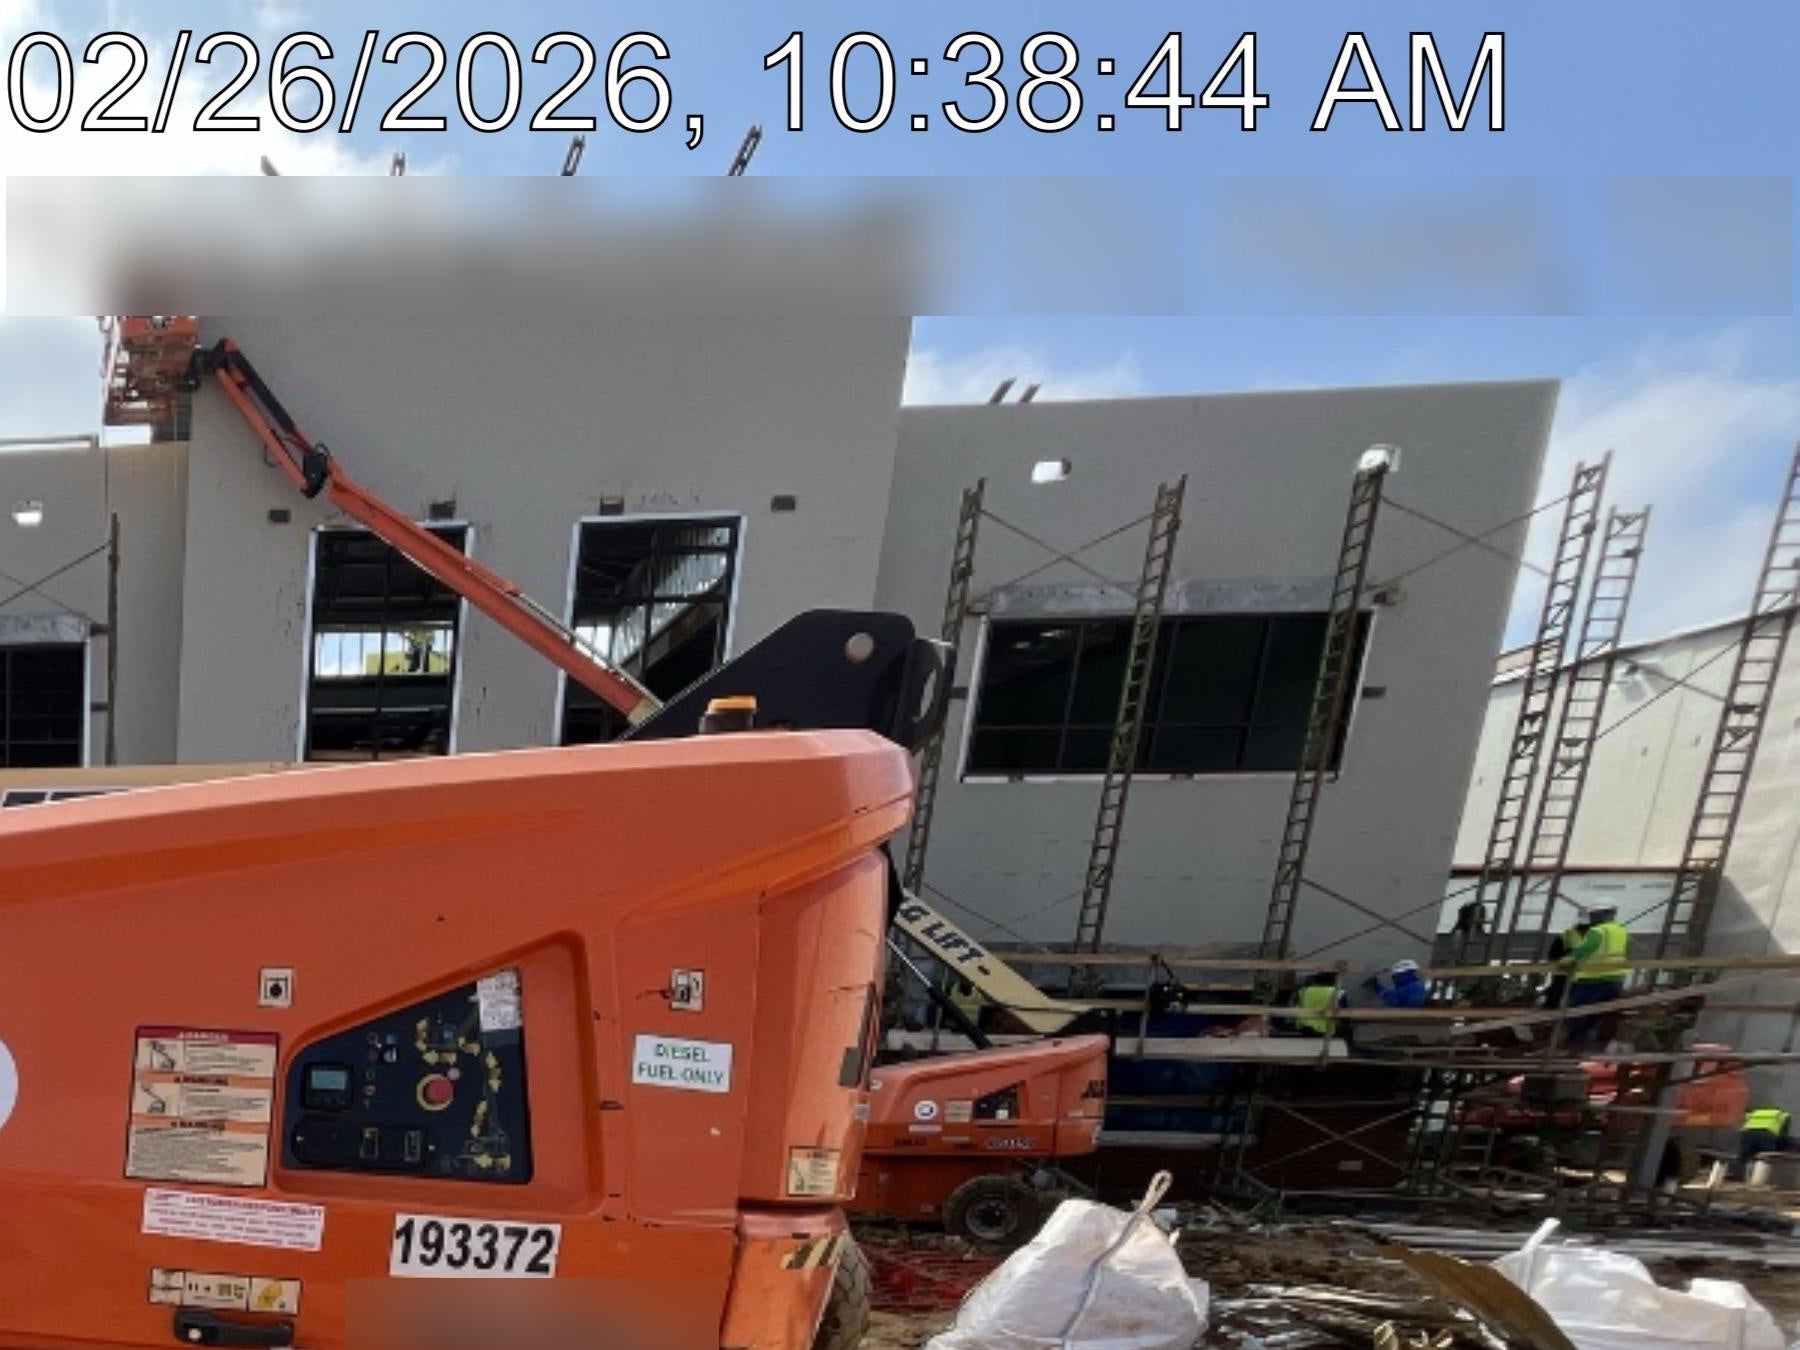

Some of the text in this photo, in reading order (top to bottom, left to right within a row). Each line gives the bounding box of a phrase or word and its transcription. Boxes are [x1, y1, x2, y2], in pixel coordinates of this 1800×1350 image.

[654, 1043, 712, 1062] DIESEL
[638, 1063, 724, 1086] FUEL ONLY
[395, 1217, 555, 1275] 193372
